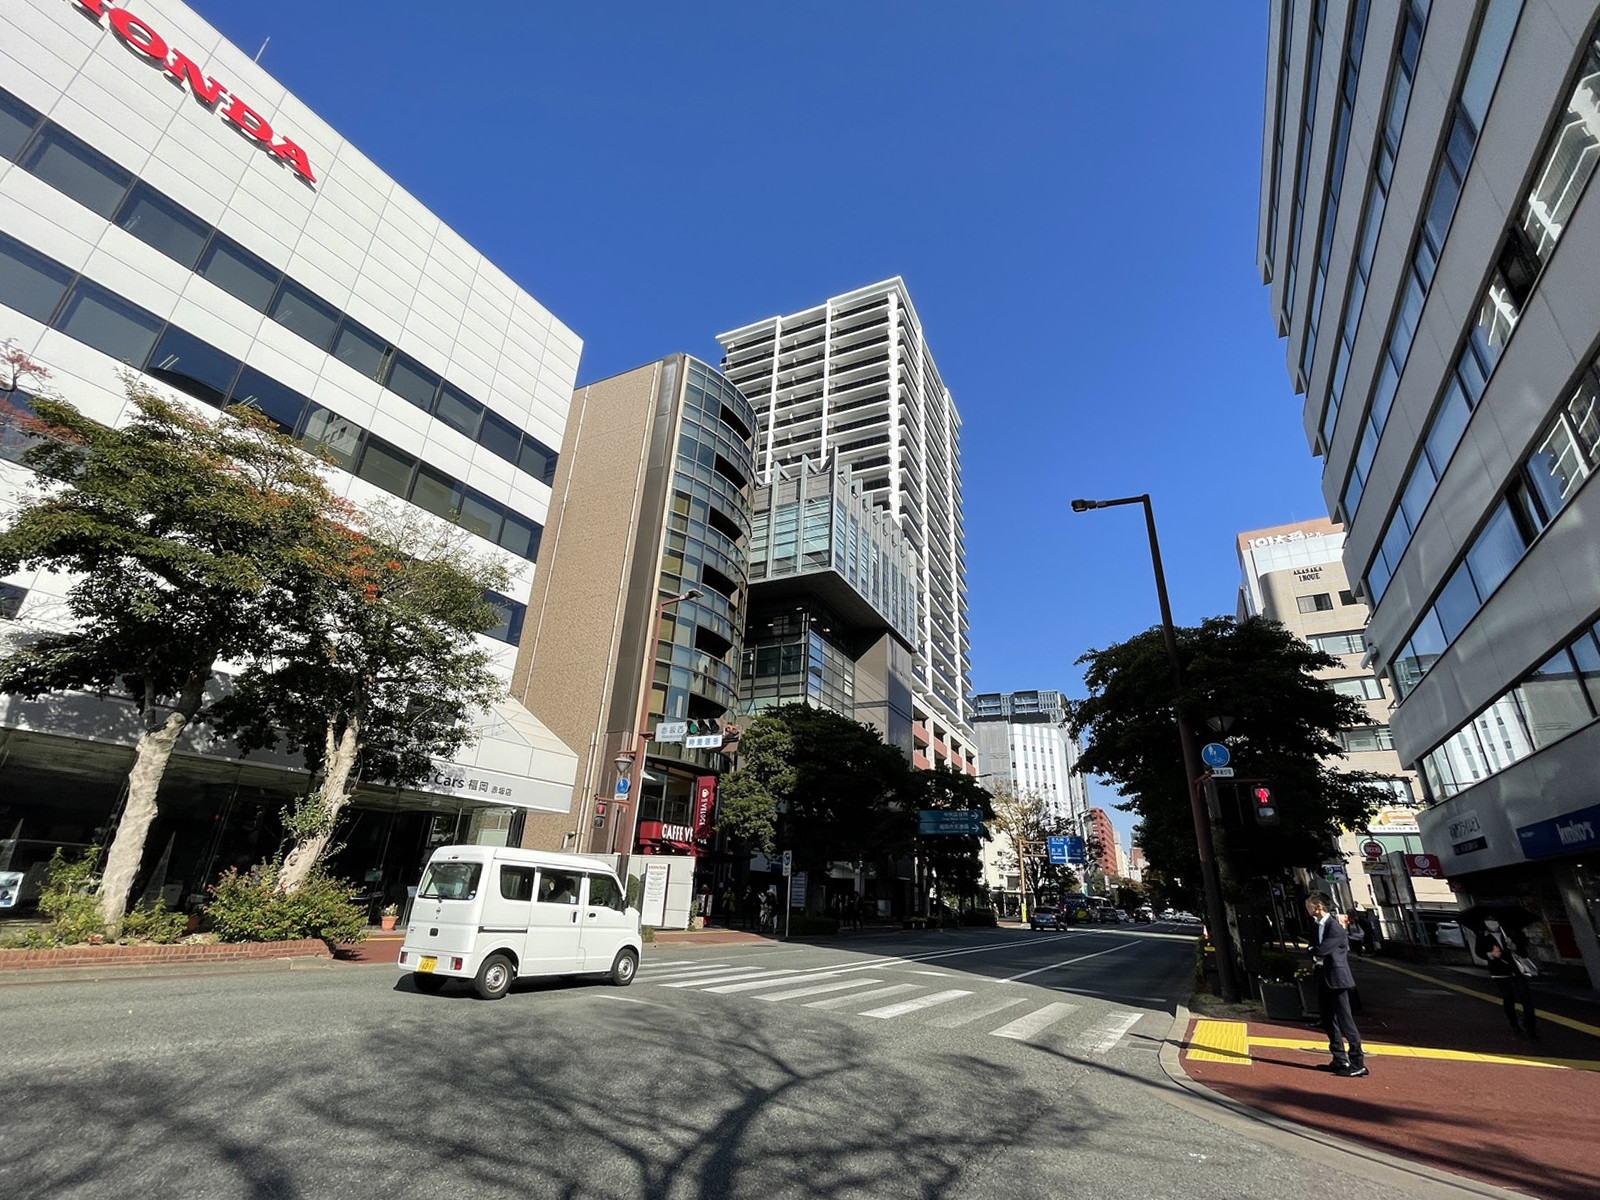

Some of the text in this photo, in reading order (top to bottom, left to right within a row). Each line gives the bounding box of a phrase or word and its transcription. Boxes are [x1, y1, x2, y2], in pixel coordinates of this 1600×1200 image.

[1293, 566, 1323, 576] AKASAKA
[1298, 573, 1321, 582] INOUE
[434, 771, 465, 789] Cars
